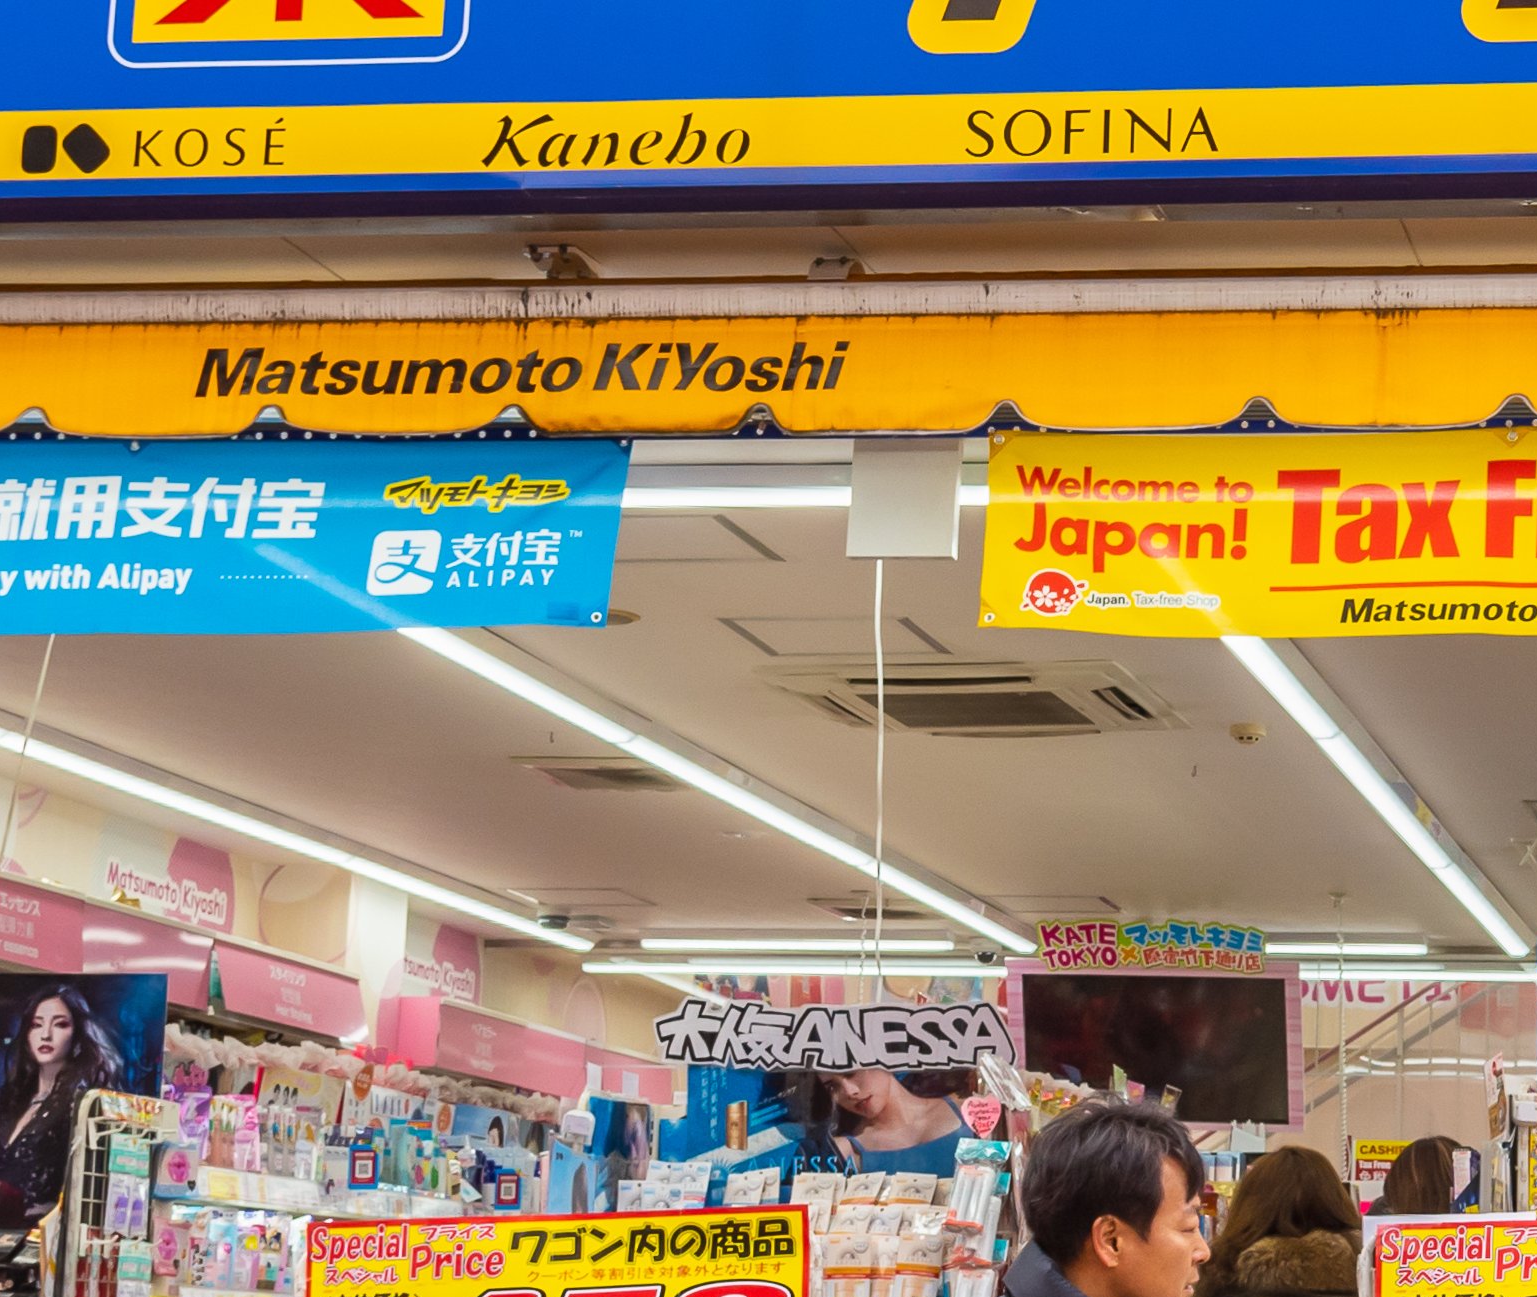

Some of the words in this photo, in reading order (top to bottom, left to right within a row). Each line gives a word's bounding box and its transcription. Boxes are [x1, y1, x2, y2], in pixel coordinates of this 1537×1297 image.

[133, 121, 287, 168] KOSÉ
[481, 112, 751, 169] Kanebo
[965, 106, 1219, 158] SOFINA
[194, 346, 582, 398] Matsumoto
[592, 341, 850, 393] KiYoshi
[1015, 465, 1206, 505] Welcome
[1215, 472, 1254, 505] to
[1276, 467, 1463, 566] Tax
[445, 528, 562, 569] 支付宝
[1013, 503, 1250, 573] Japan!
[18, 561, 92, 592] with
[98, 561, 194, 598] Alipay
[446, 568, 555, 588] ALIPAY
[106, 861, 179, 905] Matsumoto
[181, 886, 228, 921] Kiyoshi
[1040, 923, 1117, 948] KATE
[1043, 947, 1118, 969] TOKYO
[311, 1225, 407, 1264] Special
[510, 1219, 796, 1266] ワゴン内の商品
[1379, 1226, 1493, 1265] Special
[325, 1265, 399, 1286] スペシャル
[409, 1244, 505, 1281] Price
[527, 1262, 787, 1283] クーポン等割引き対象外となります
[1395, 1267, 1483, 1287] スペシャル
